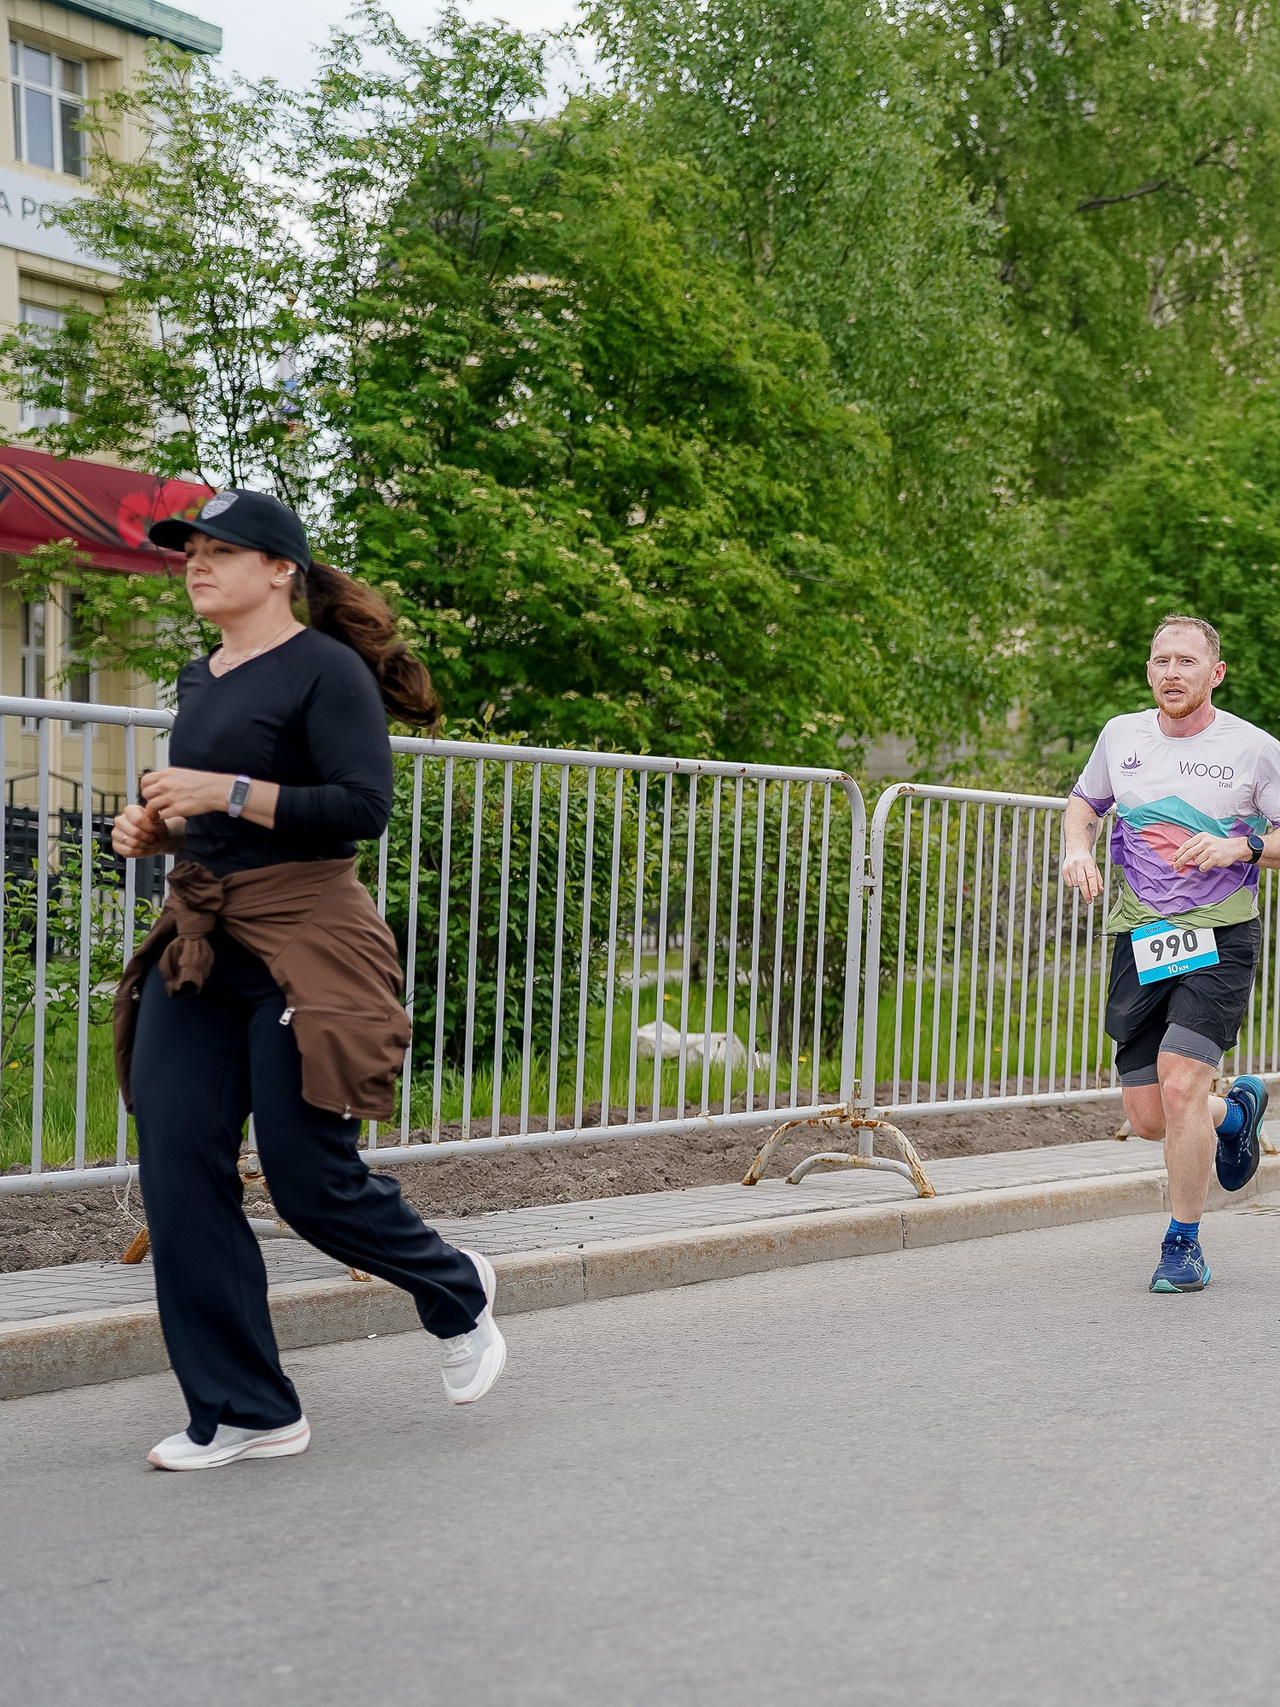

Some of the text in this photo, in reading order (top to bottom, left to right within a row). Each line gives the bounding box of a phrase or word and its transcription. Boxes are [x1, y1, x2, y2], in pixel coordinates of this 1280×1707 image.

[1179, 761, 1234, 780] WOOD
[1218, 781, 1233, 789] trail
[1150, 930, 1198, 962] 990
[1167, 964, 1178, 975] 10
